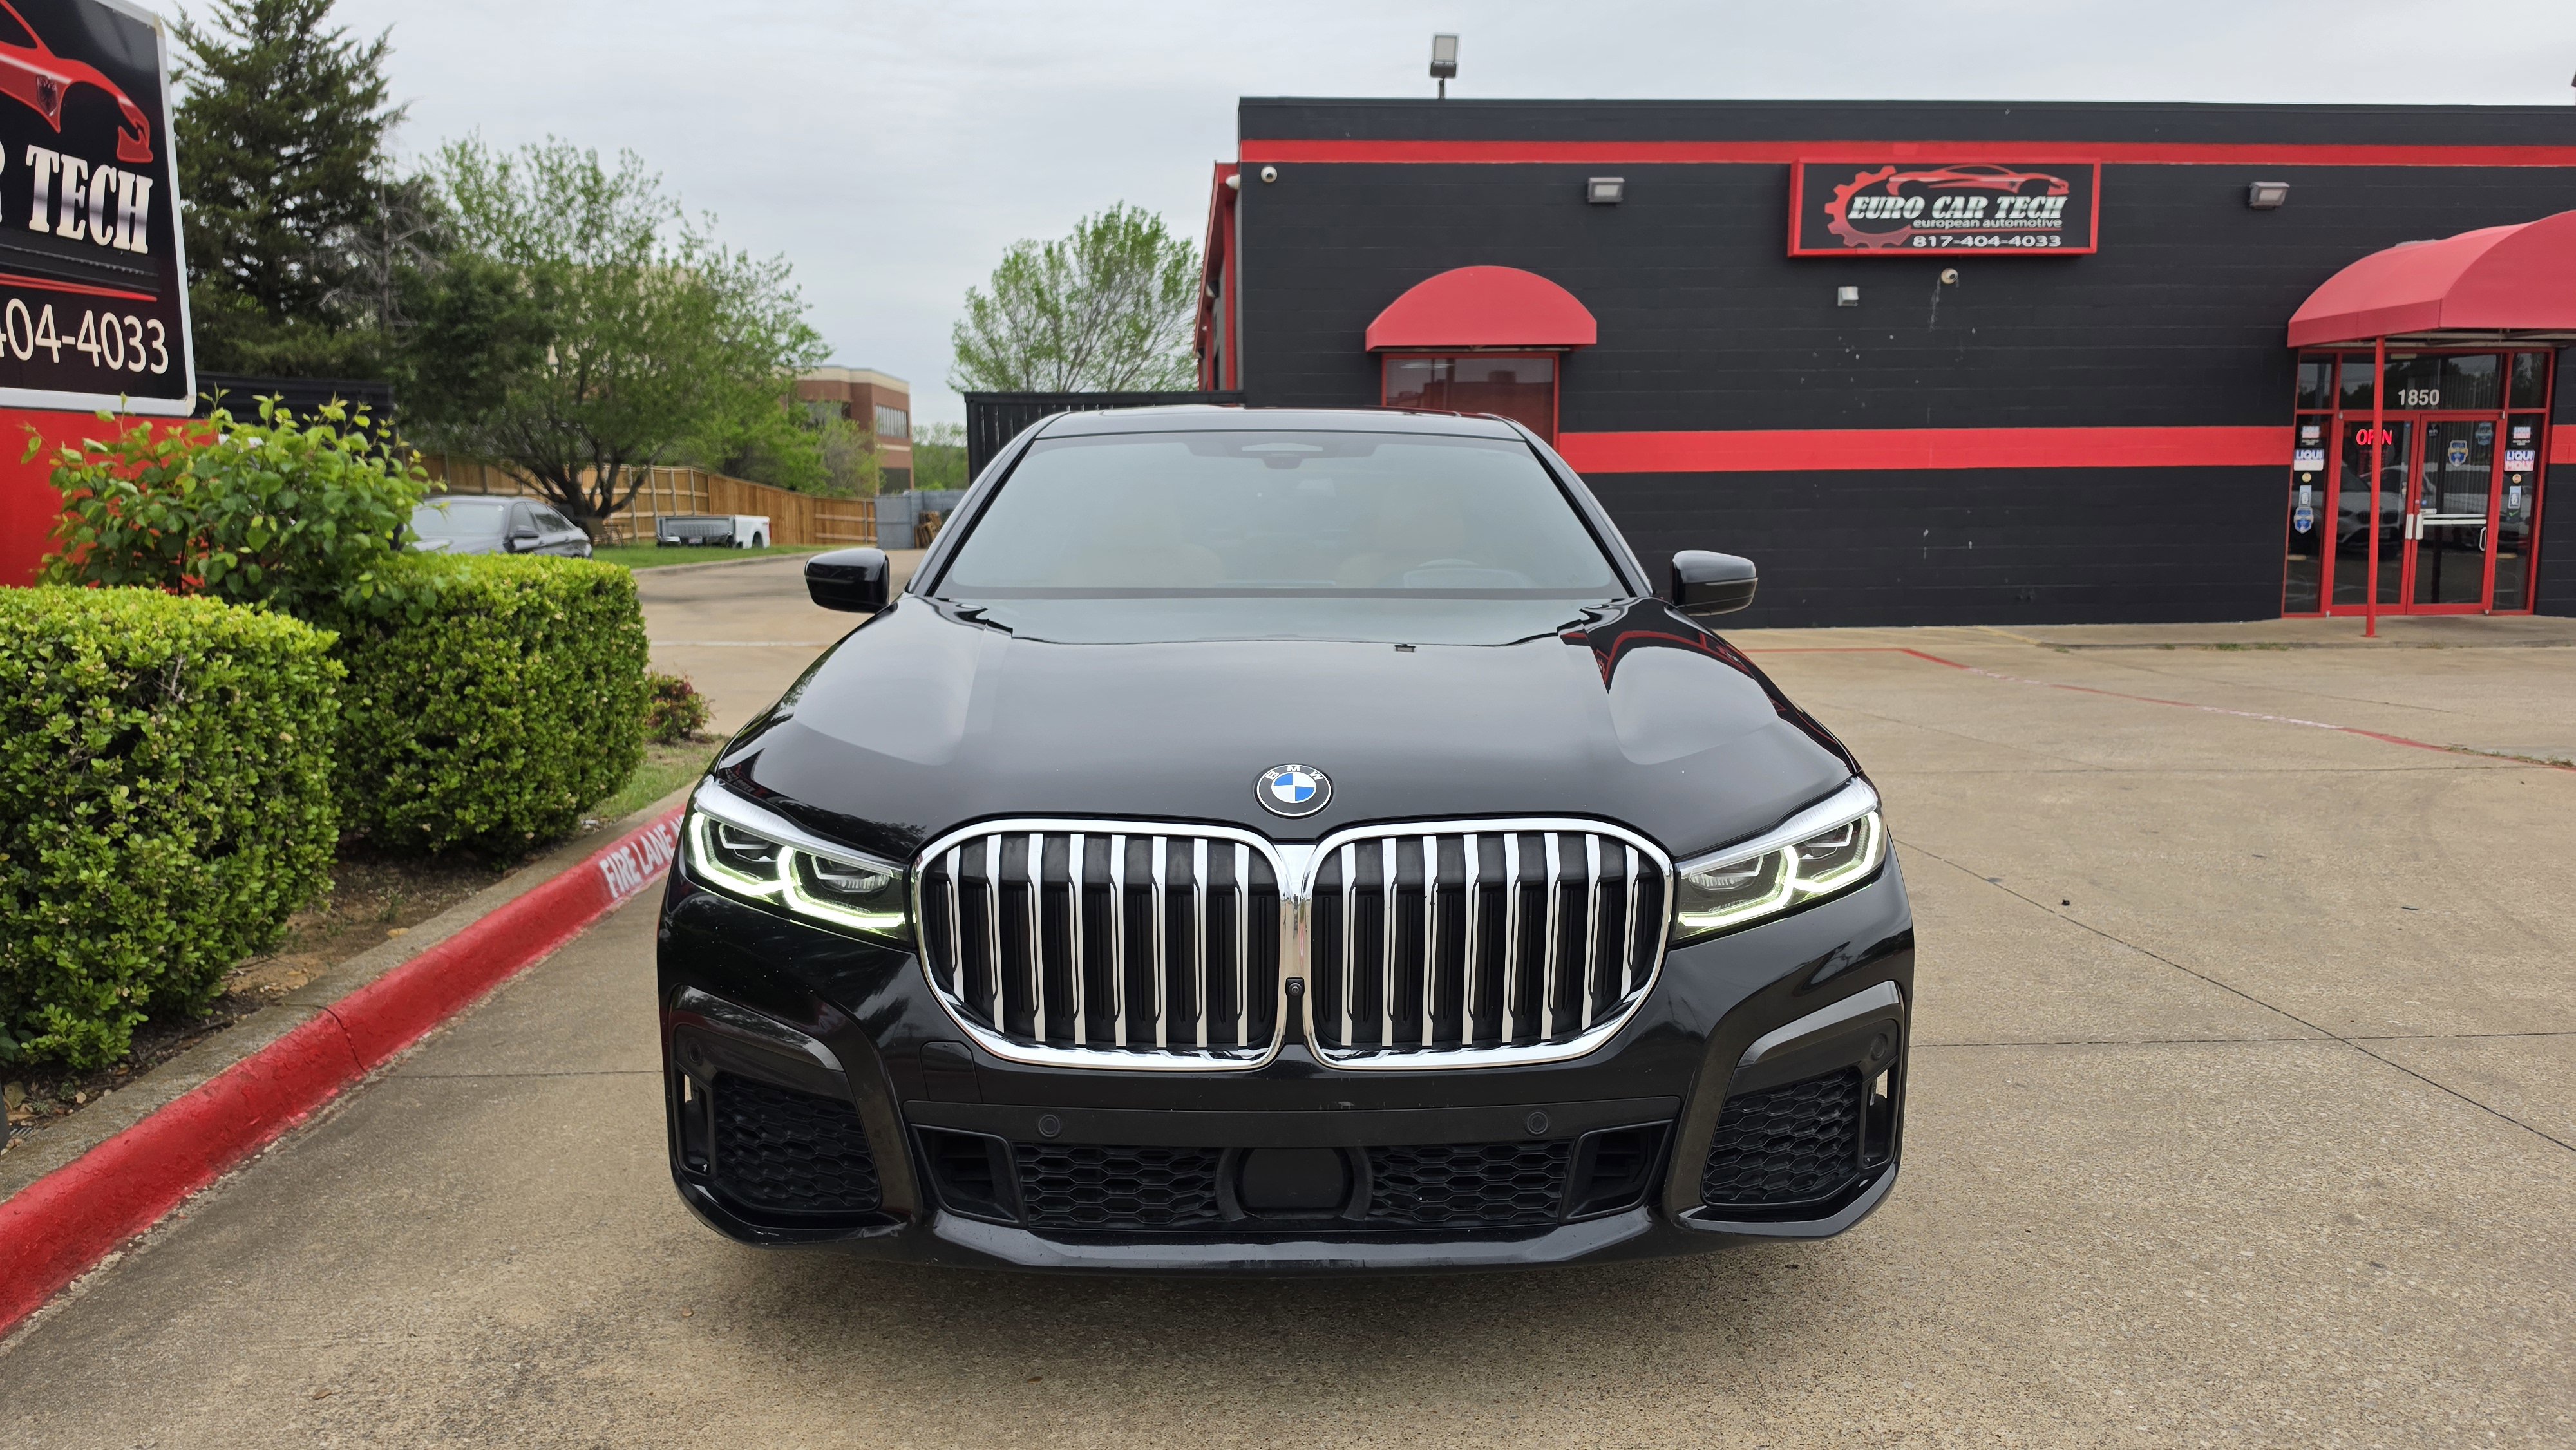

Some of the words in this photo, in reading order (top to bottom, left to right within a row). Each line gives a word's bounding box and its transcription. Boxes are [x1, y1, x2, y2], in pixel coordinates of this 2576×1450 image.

[26, 144, 153, 254] TECH
[1848, 196, 1926, 219] EURO
[1931, 196, 1989, 219] CAR
[1994, 196, 2067, 219] TECH
[1913, 219, 1980, 229] european
[1982, 218, 2063, 229] automotive
[1913, 235, 2061, 247] 817-404-4033
[2398, 388, 2440, 406] 1850
[2356, 428, 2392, 446] OPN
[2295, 449, 2323, 460] LIQUI
[2506, 451, 2534, 461] LIQUI
[1264, 766, 1324, 780] BMW
[599, 845, 641, 899] FIRE
[630, 823, 676, 875] LANE
